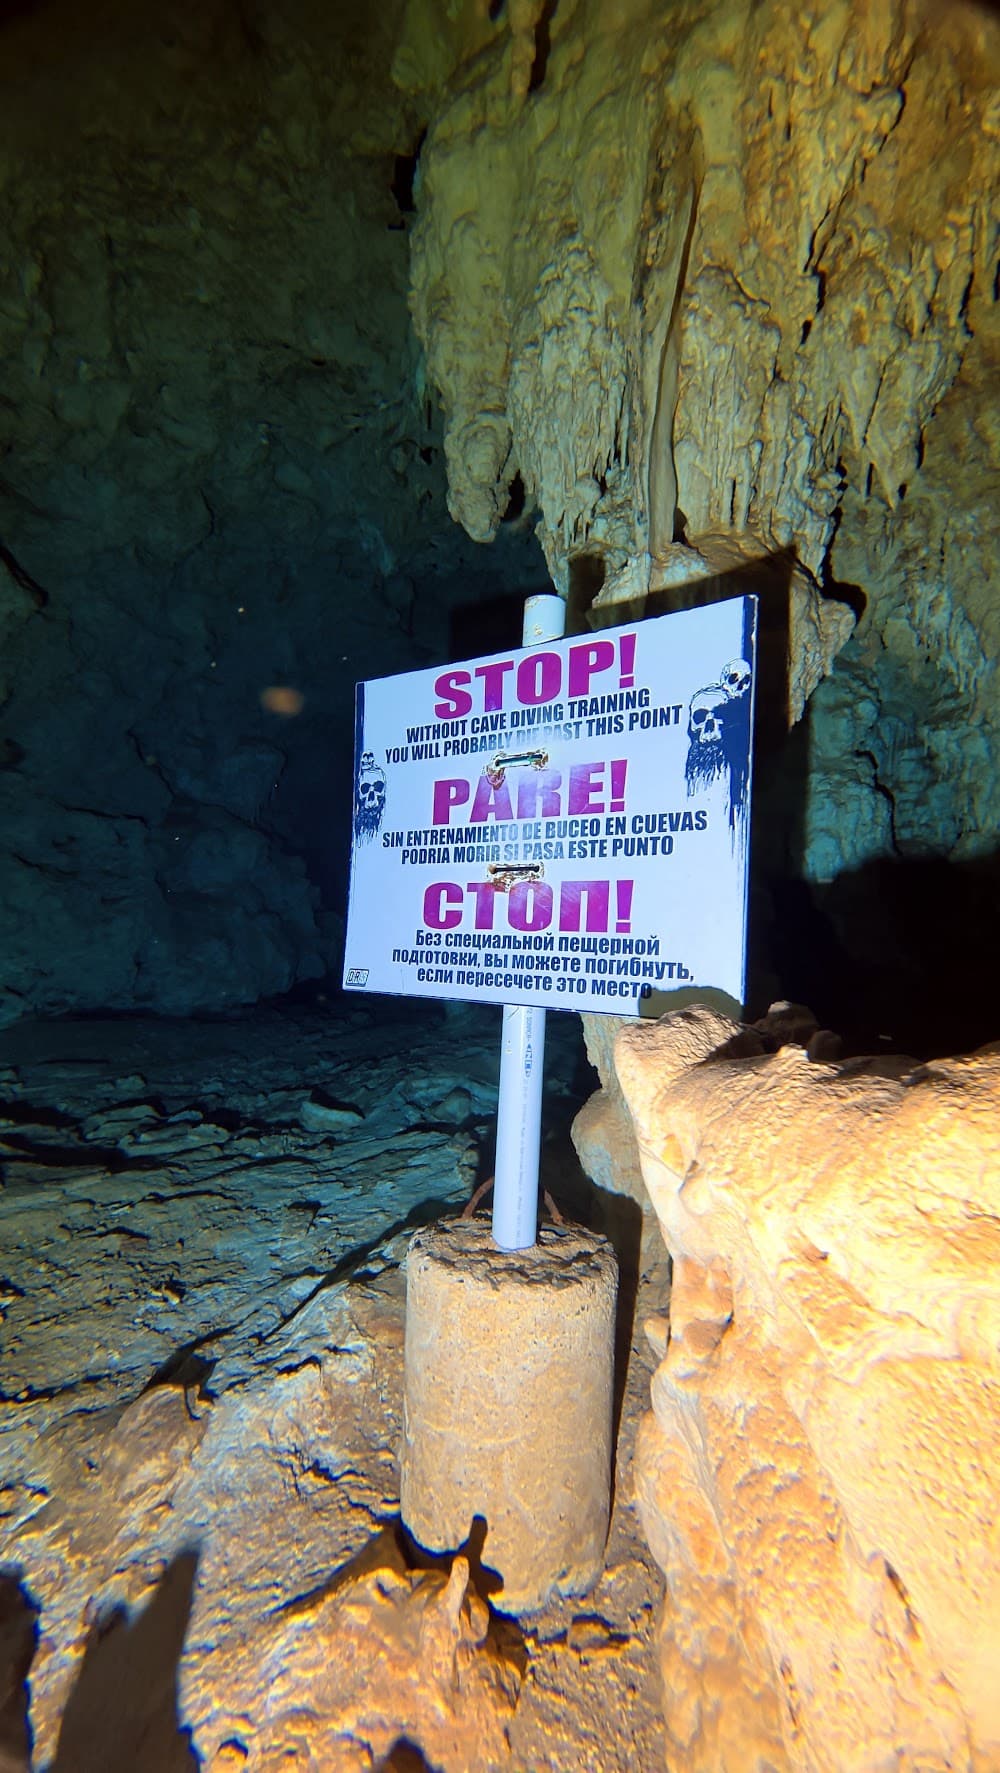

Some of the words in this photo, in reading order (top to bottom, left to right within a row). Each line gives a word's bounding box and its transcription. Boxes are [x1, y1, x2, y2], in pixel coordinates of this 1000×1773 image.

[434, 633, 637, 720] STOP!
[385, 747, 409, 764] YOU
[411, 742, 441, 762] WILL
[443, 730, 512, 757] PROBABLY
[586, 714, 625, 737] THIS
[628, 704, 683, 732] POINT
[406, 719, 468, 744] WITHOUT
[471, 712, 507, 736] CAVE
[510, 703, 564, 728] DIVING
[567, 688, 651, 719] TRAINING
[432, 759, 628, 826] PARE!
[382, 831, 404, 848] SIN
[406, 824, 519, 847] ENTRENAMIENTO
[522, 821, 542, 841] DE
[545, 815, 601, 840] BUCEO
[605, 816, 628, 836] EN
[631, 810, 708, 834] CUEVAS
[401, 846, 451, 865] PODRIA
[453, 845, 500, 864] MORIR
[503, 844, 520, 862] SI
[523, 841, 565, 861] PASA
[568, 839, 608, 859] ESTE
[612, 835, 674, 857] PUNTO
[423, 879, 635, 934] СТОП!
[392, 949, 481, 969] подготовки,
[484, 954, 508, 969] вы
[511, 954, 581, 973] можете
[585, 957, 695, 982] погибнуть,
[415, 930, 442, 947] Без
[445, 931, 554, 952] специальной
[558, 935, 660, 957] пещерной
[417, 967, 453, 984] если
[456, 971, 552, 992] пересечете
[556, 978, 587, 995] это
[591, 980, 652, 999] место
